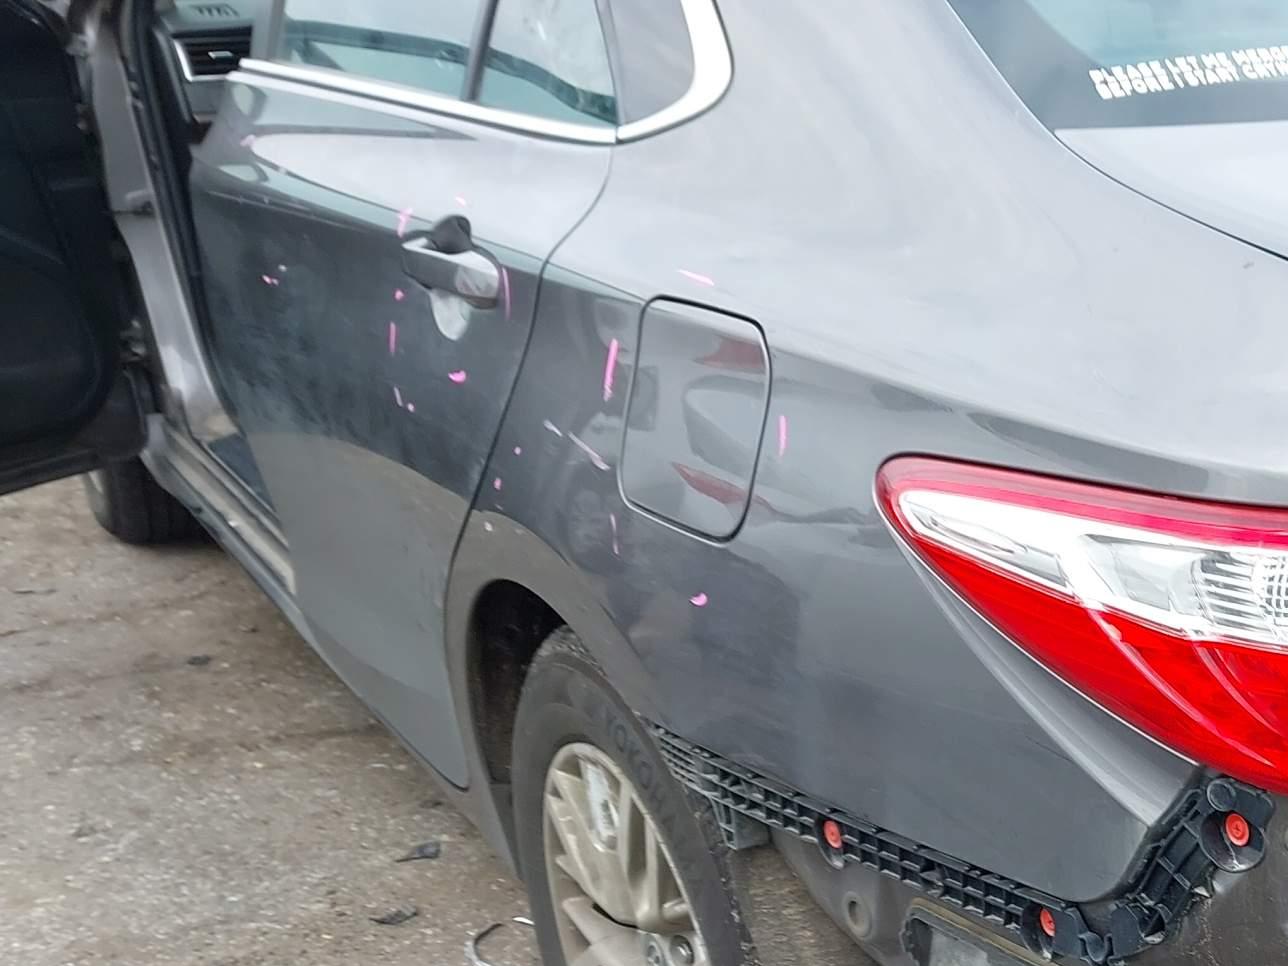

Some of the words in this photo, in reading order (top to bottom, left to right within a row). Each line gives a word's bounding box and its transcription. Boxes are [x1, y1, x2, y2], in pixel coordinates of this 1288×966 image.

[1088, 60, 1166, 84] PLEASE
[1095, 75, 1174, 100] BEFORE
[1183, 65, 1241, 87] START
